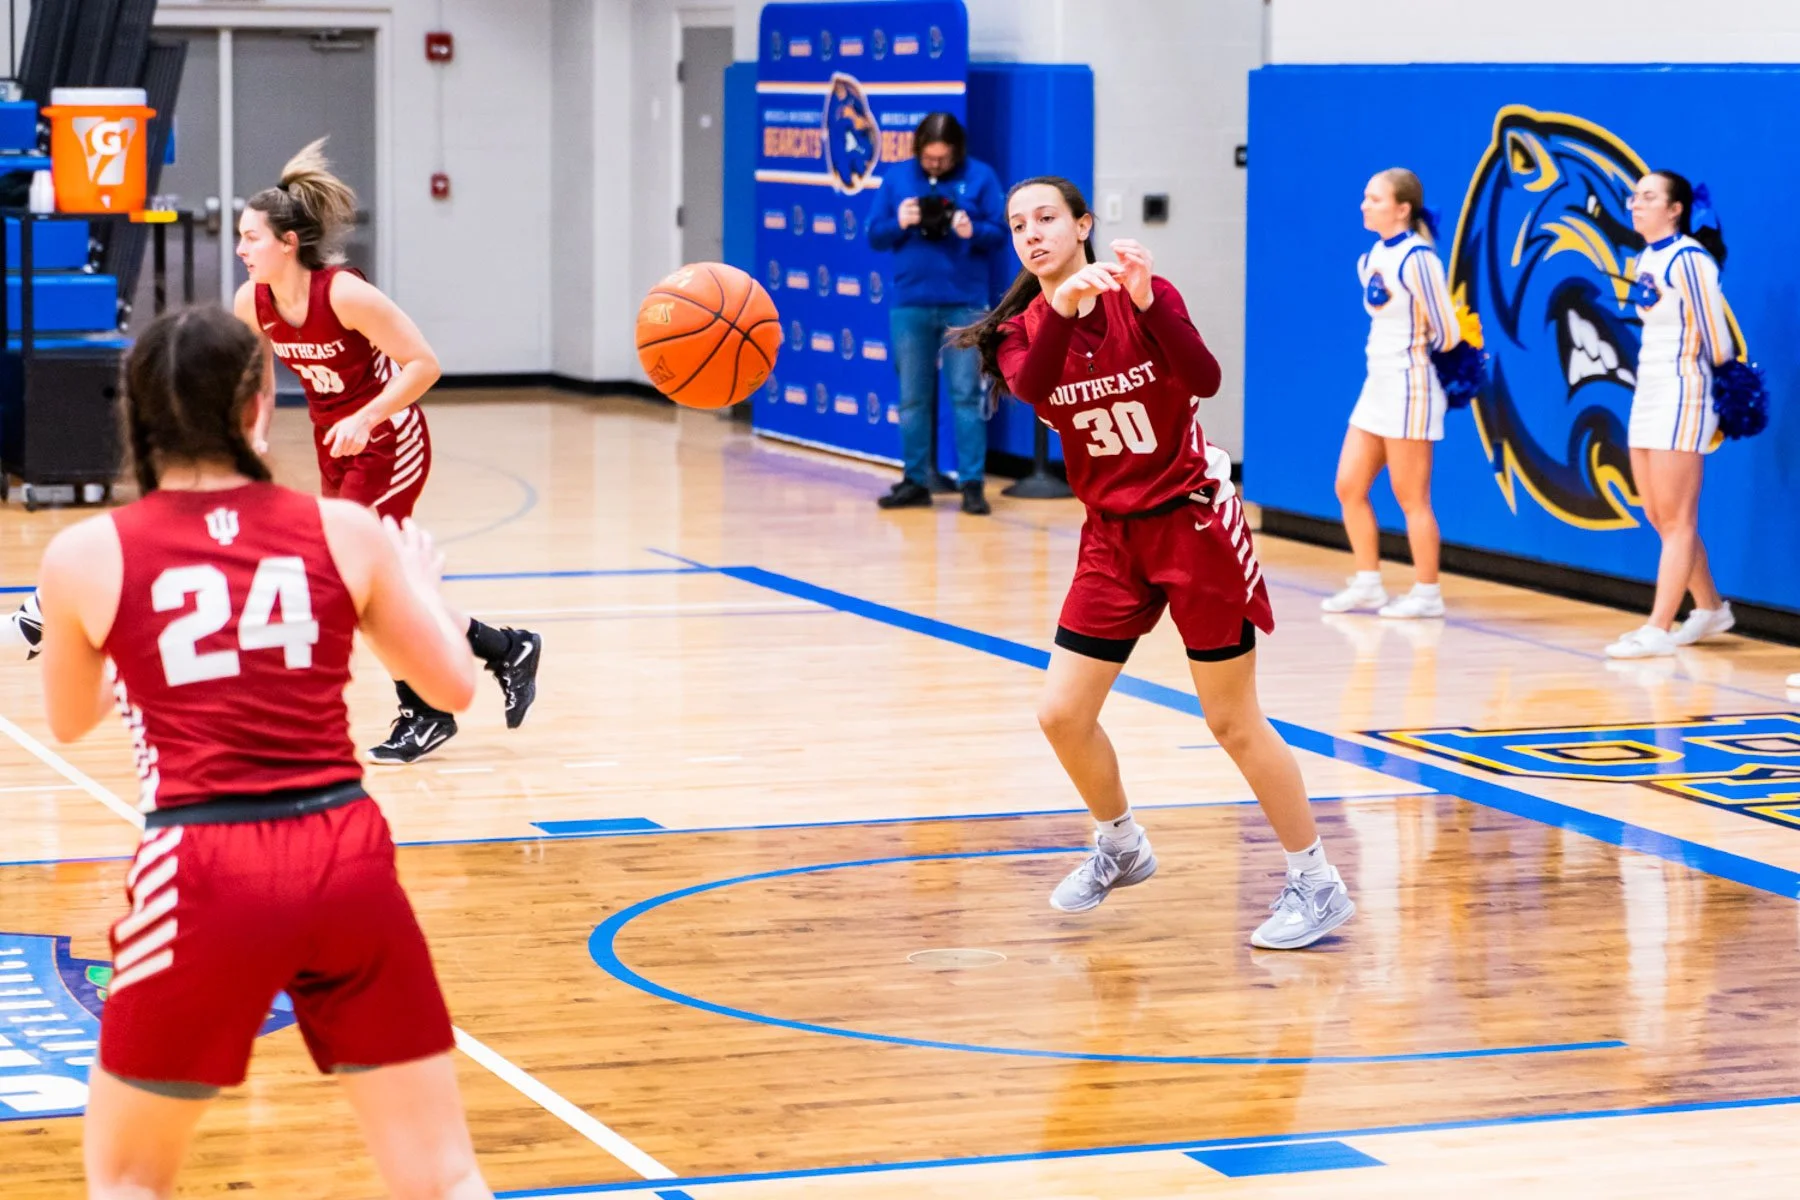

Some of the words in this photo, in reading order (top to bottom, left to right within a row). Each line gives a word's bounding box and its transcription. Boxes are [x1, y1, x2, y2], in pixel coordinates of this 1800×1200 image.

[92, 121, 121, 155] G
[270, 339, 345, 359] OUTHEAST
[1049, 360, 1156, 406] OUTHEAST
[1072, 400, 1158, 457] 30
[151, 556, 319, 687] 24
